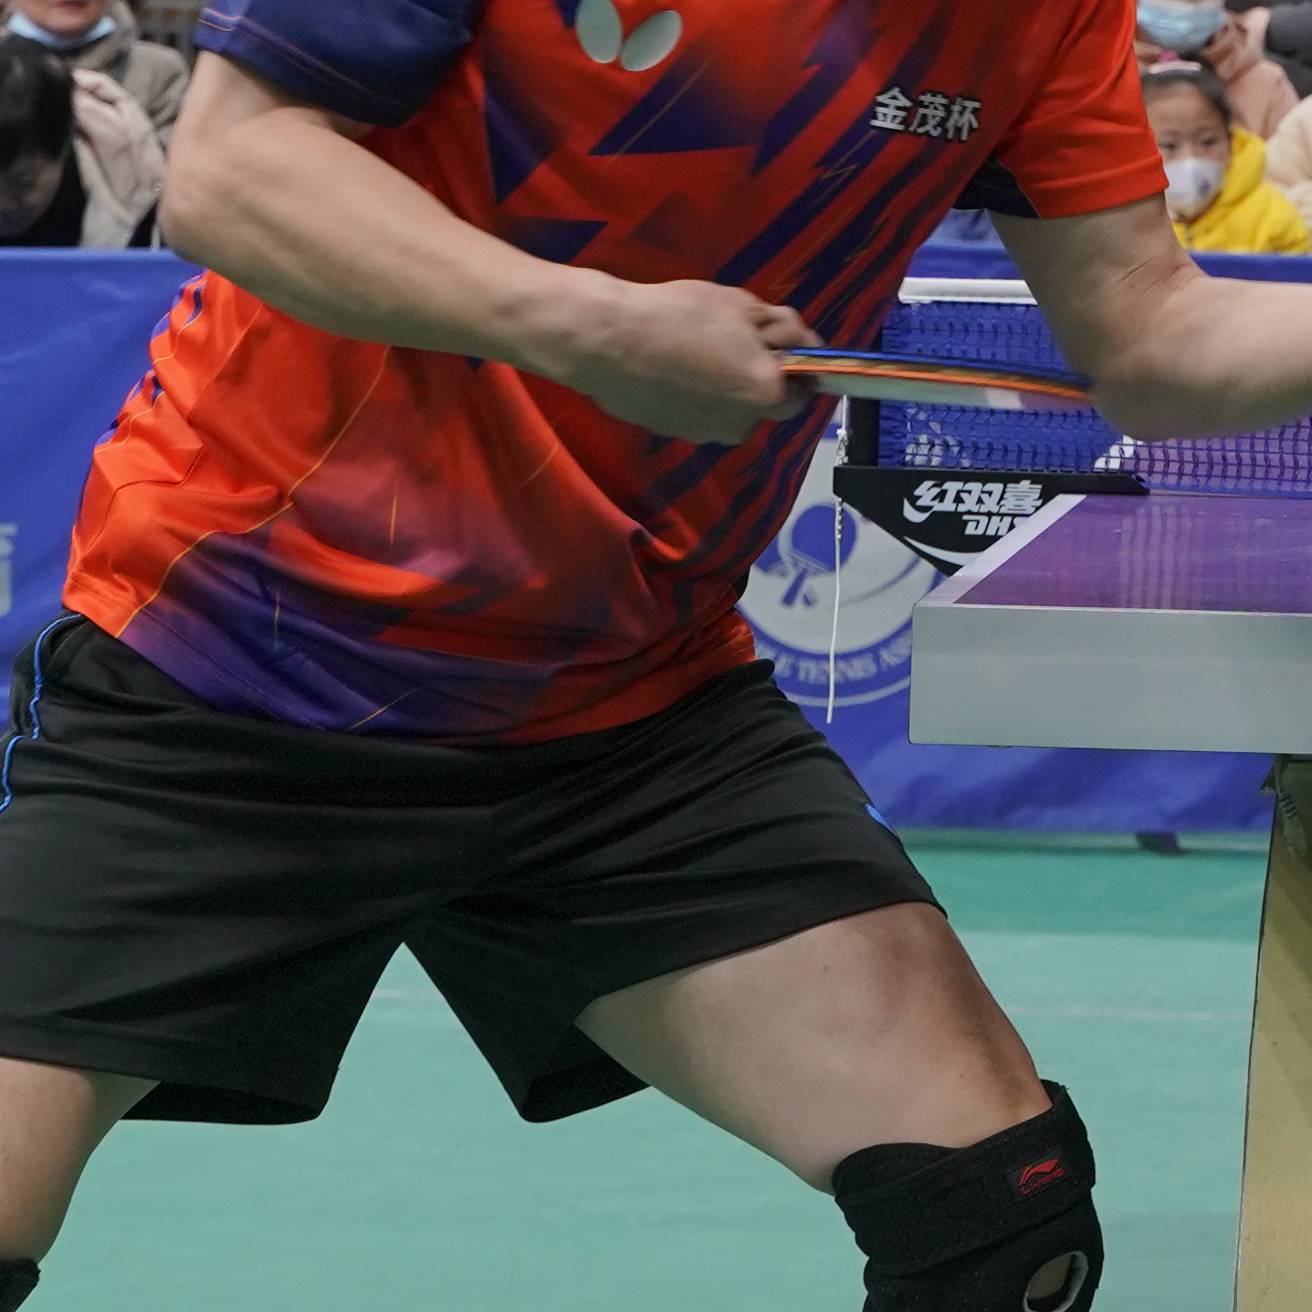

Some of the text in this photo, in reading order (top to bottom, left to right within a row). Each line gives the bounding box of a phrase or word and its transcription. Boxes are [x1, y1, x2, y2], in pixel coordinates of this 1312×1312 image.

[869, 86, 982, 141] 金茂杯
[903, 479, 1044, 524] 红双喜
